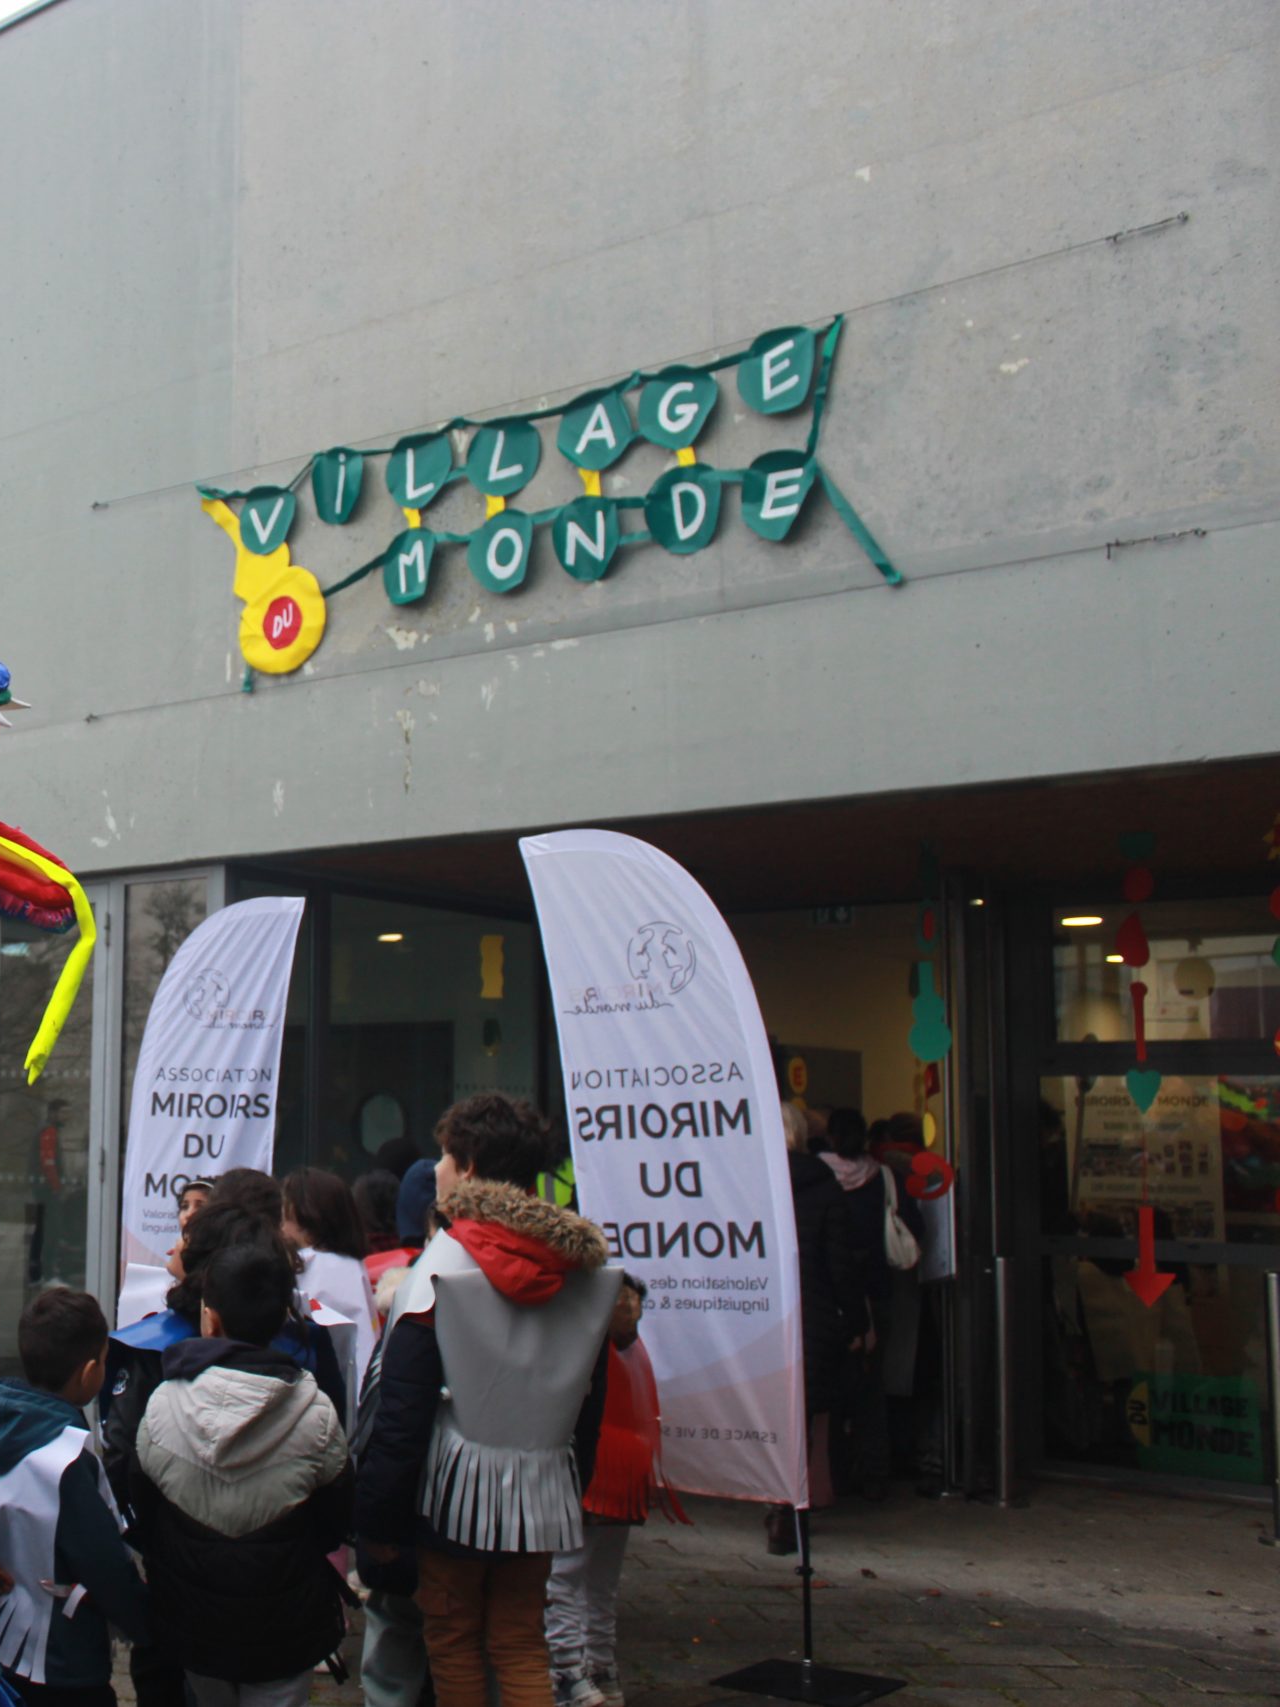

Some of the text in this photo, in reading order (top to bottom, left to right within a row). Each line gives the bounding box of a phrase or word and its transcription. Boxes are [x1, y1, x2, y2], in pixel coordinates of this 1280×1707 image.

[396, 467, 804, 594] MONDE
[272, 602, 293, 639] DU
[156, 1067, 272, 1083] ASSOCIATON
[150, 1092, 271, 1119] MIROIRS
[184, 1134, 226, 1159] DU
